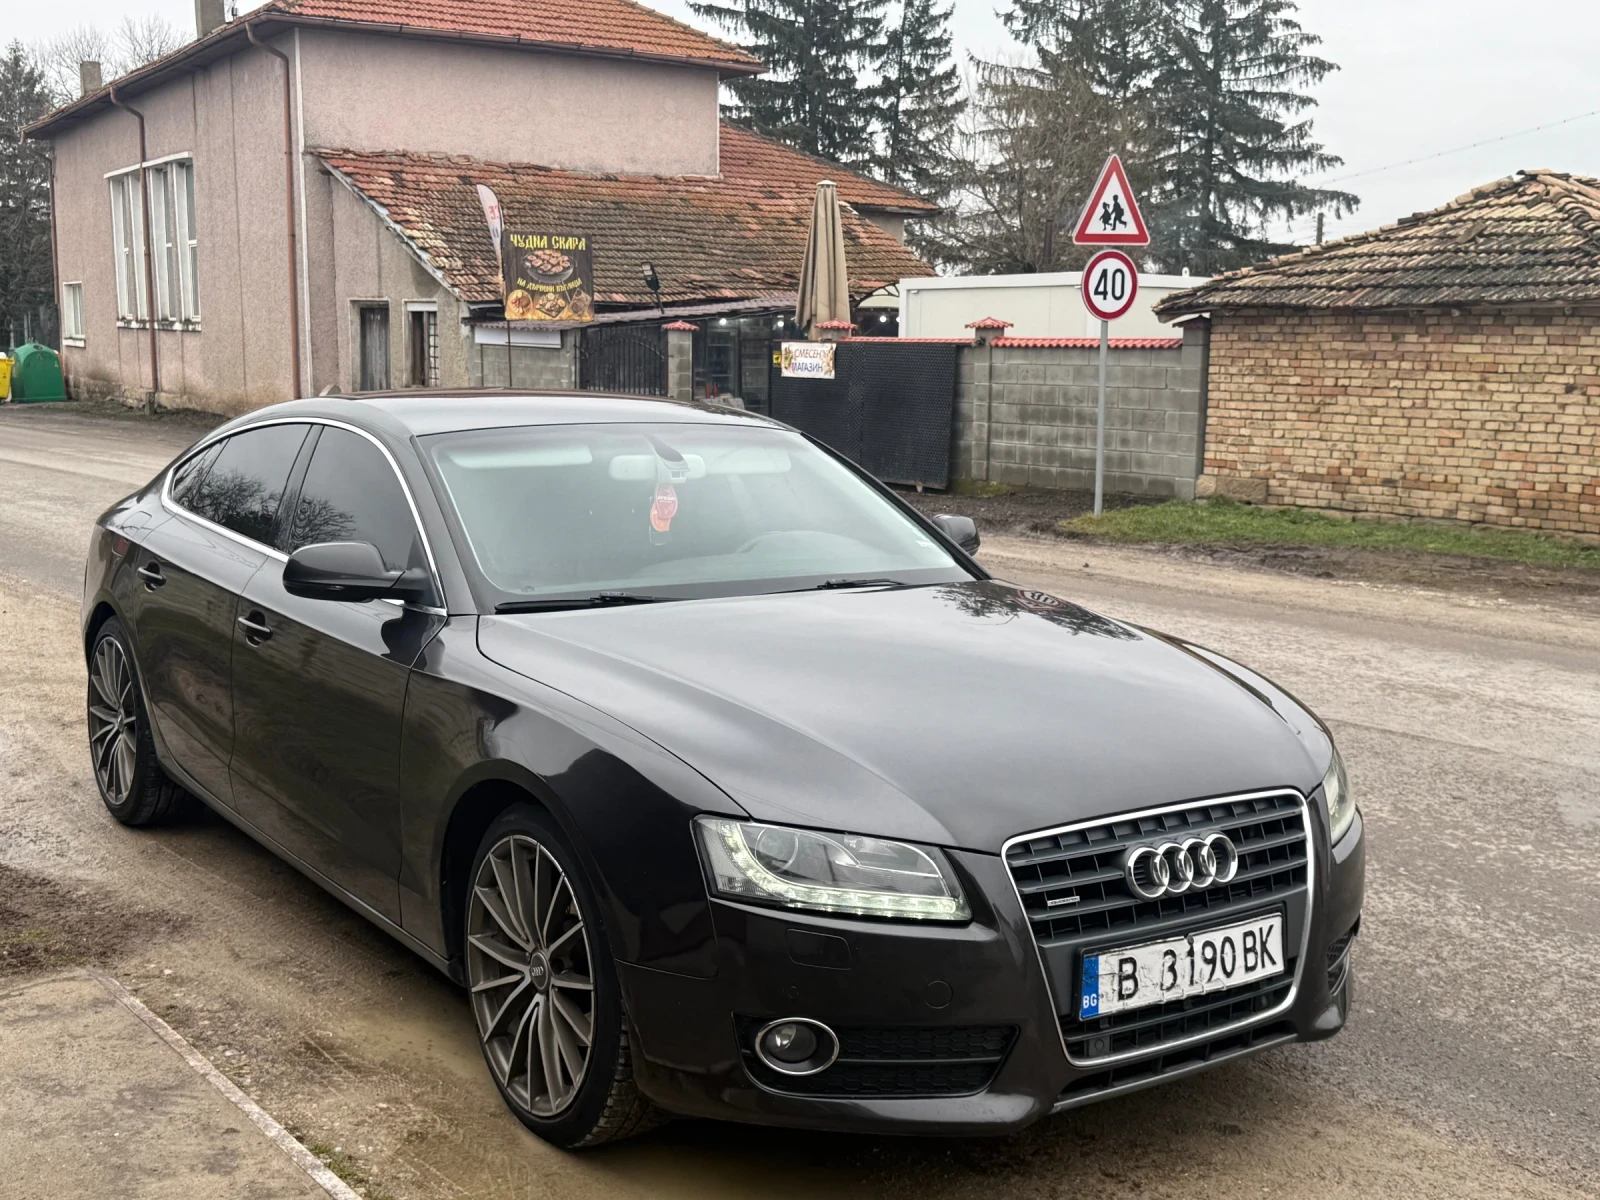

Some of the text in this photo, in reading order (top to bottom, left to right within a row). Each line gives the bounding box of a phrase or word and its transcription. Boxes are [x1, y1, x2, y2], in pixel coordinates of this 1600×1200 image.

[510, 234, 586, 251] ЧУДНА СКАРА
[1094, 268, 1125, 301] 40
[794, 349, 822, 359] СМЕСЕН
[792, 362, 823, 372] МАГАЗИН
[1117, 924, 1277, 1002] B 3190 BK
[1083, 993, 1098, 1009] BG
